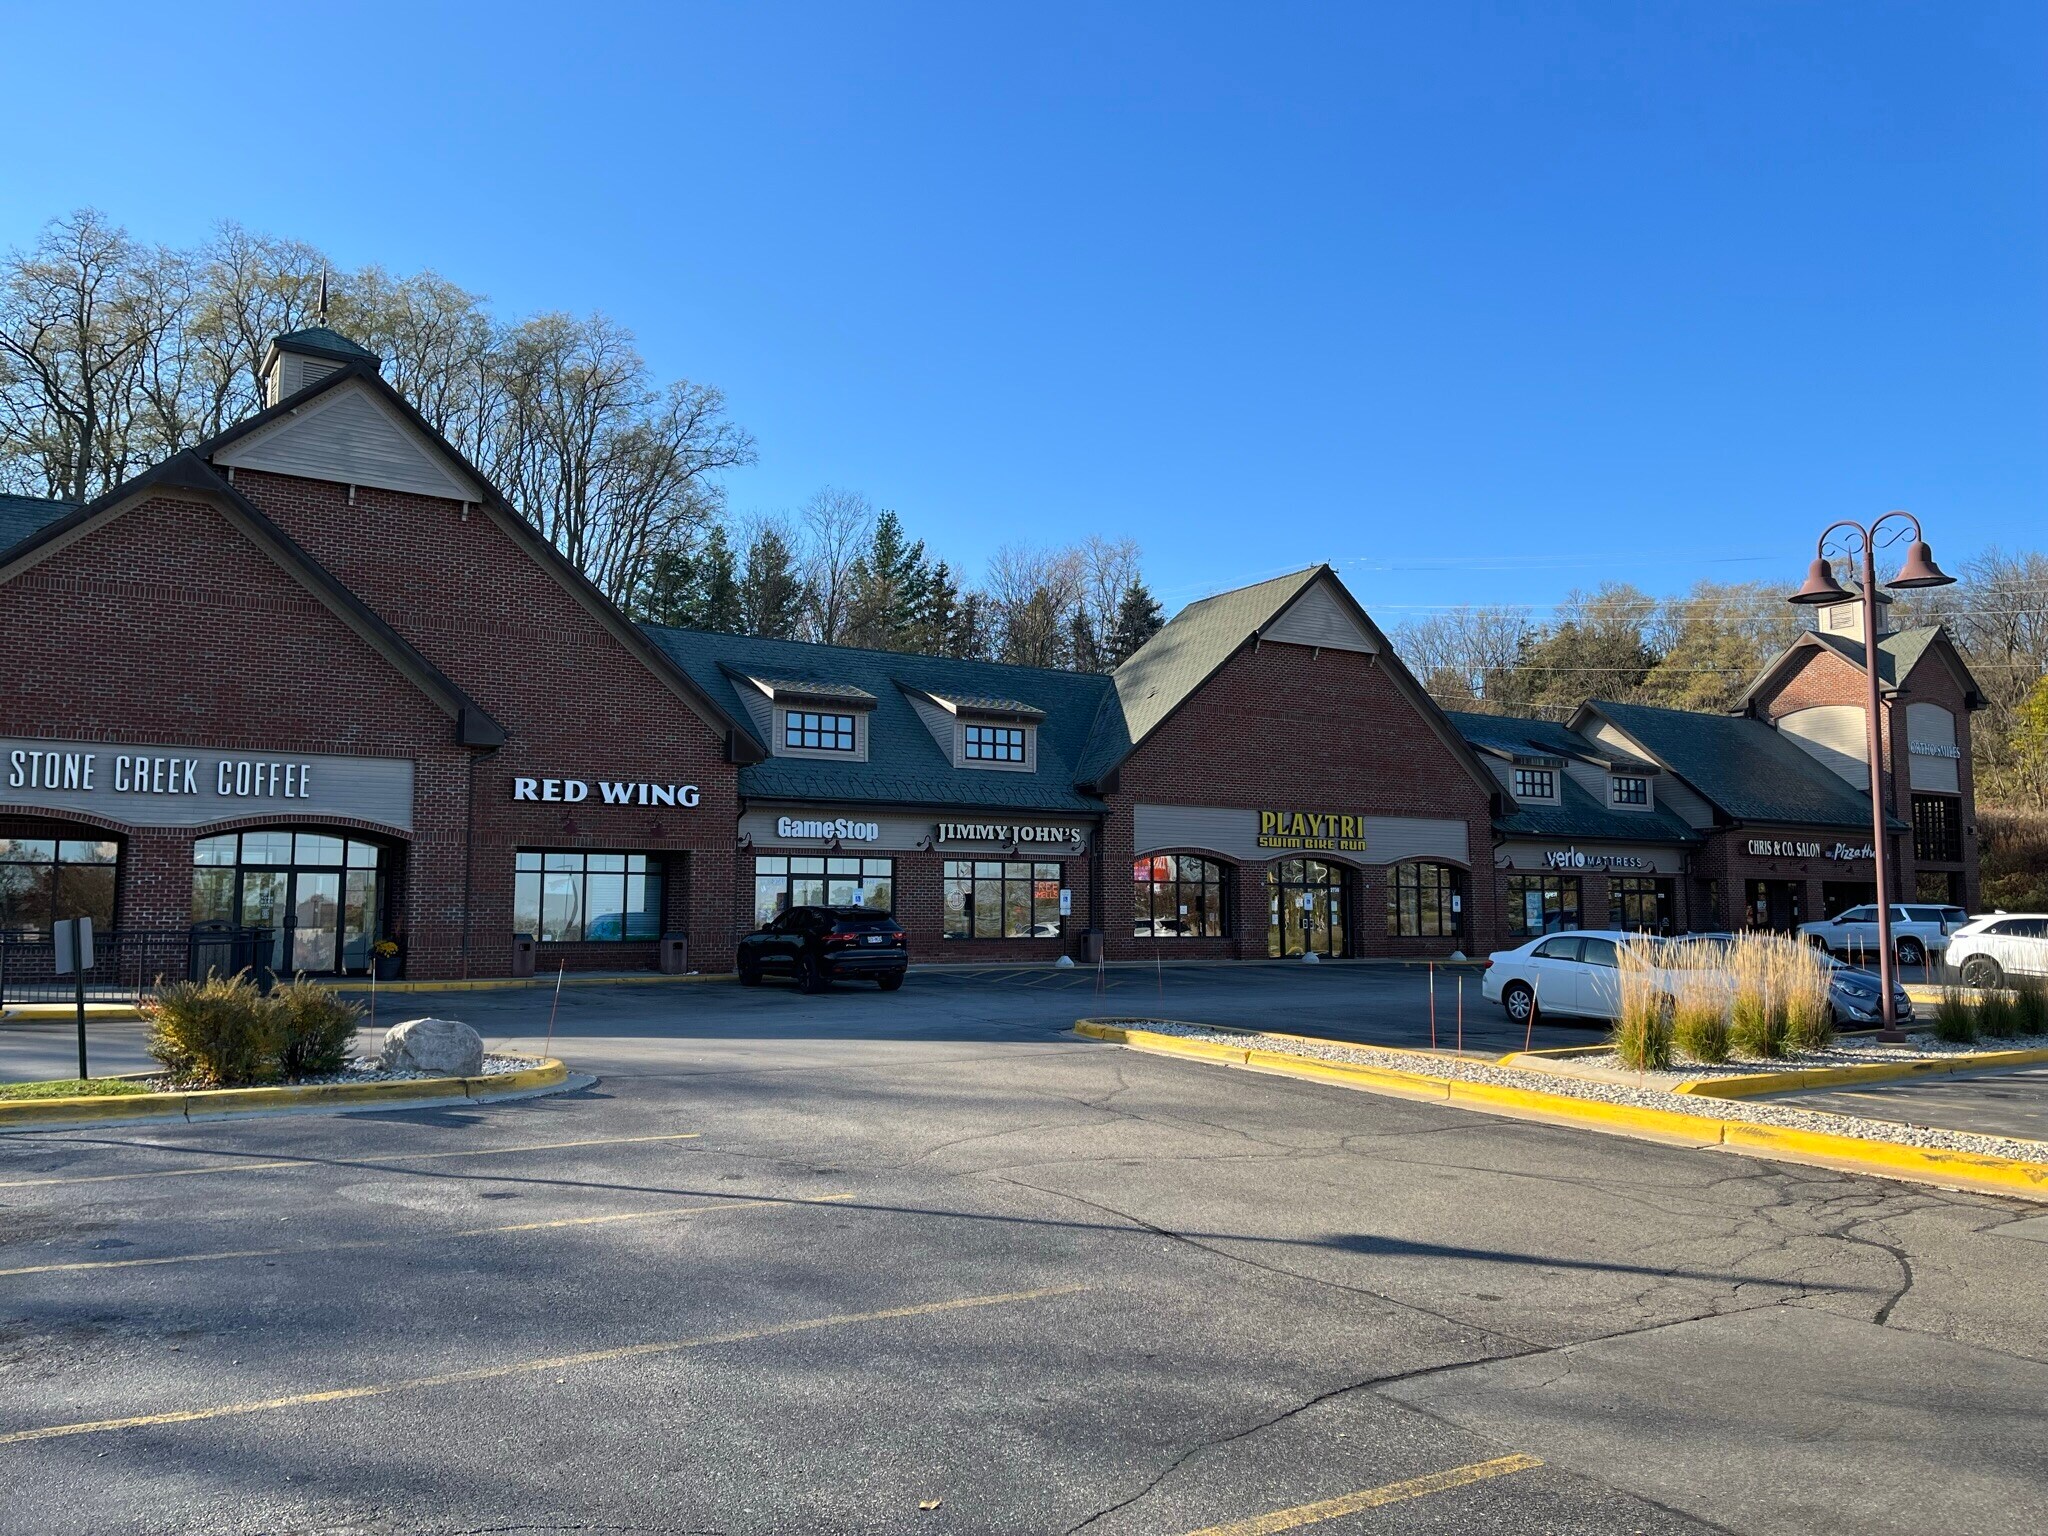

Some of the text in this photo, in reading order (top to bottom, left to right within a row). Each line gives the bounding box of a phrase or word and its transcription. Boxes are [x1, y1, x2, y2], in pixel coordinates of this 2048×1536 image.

[9, 750, 312, 798] STONE CREEK COFFEE
[513, 777, 700, 807] RED WING
[777, 816, 879, 841] GameStop
[938, 823, 1081, 844] JIMMY JOHN'S
[1261, 811, 1364, 838] PLAYTRI
[1259, 838, 1367, 851] SWIM BIKE RUN
[1748, 839, 1772, 856] CHRIS
[1773, 841, 1781, 856] &
[1796, 842, 1821, 858] SALON
[1834, 842, 1861, 860] Pizza
[1547, 846, 1642, 868] verlo MATTRESS
